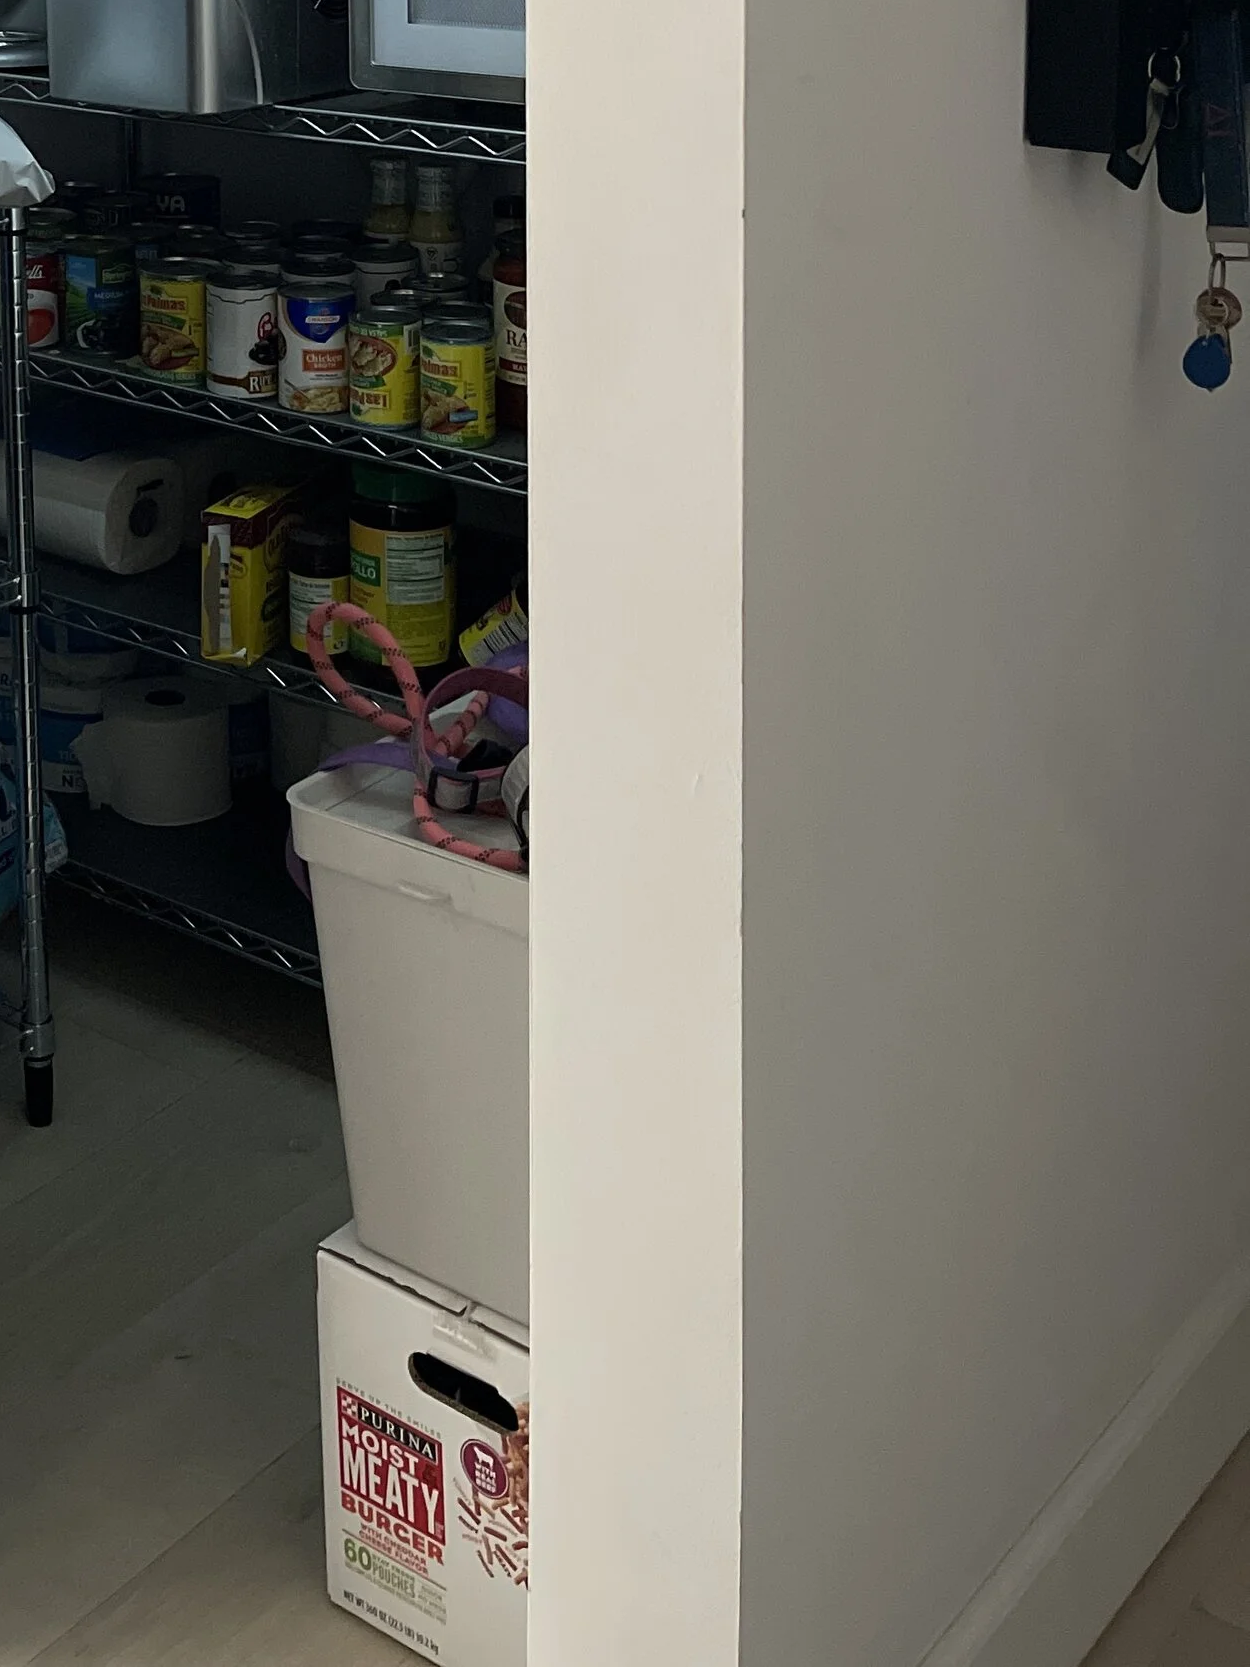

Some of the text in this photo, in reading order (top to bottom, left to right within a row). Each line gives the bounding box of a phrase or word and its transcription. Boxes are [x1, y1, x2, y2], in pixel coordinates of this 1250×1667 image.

[305, 352, 343, 363] Chicken
[341, 1416, 420, 1477] MOIST
[360, 1406, 434, 1460] PURINA
[342, 1438, 440, 1535] MEATY
[340, 1490, 445, 1566] BURGER
[360, 1522, 428, 1566] WITH CHEDDAR
[344, 1537, 372, 1571] 60
[395, 1550, 429, 1577] FLAVOR
[343, 1589, 354, 1603] NET
[372, 1561, 416, 1598] POUCHES
